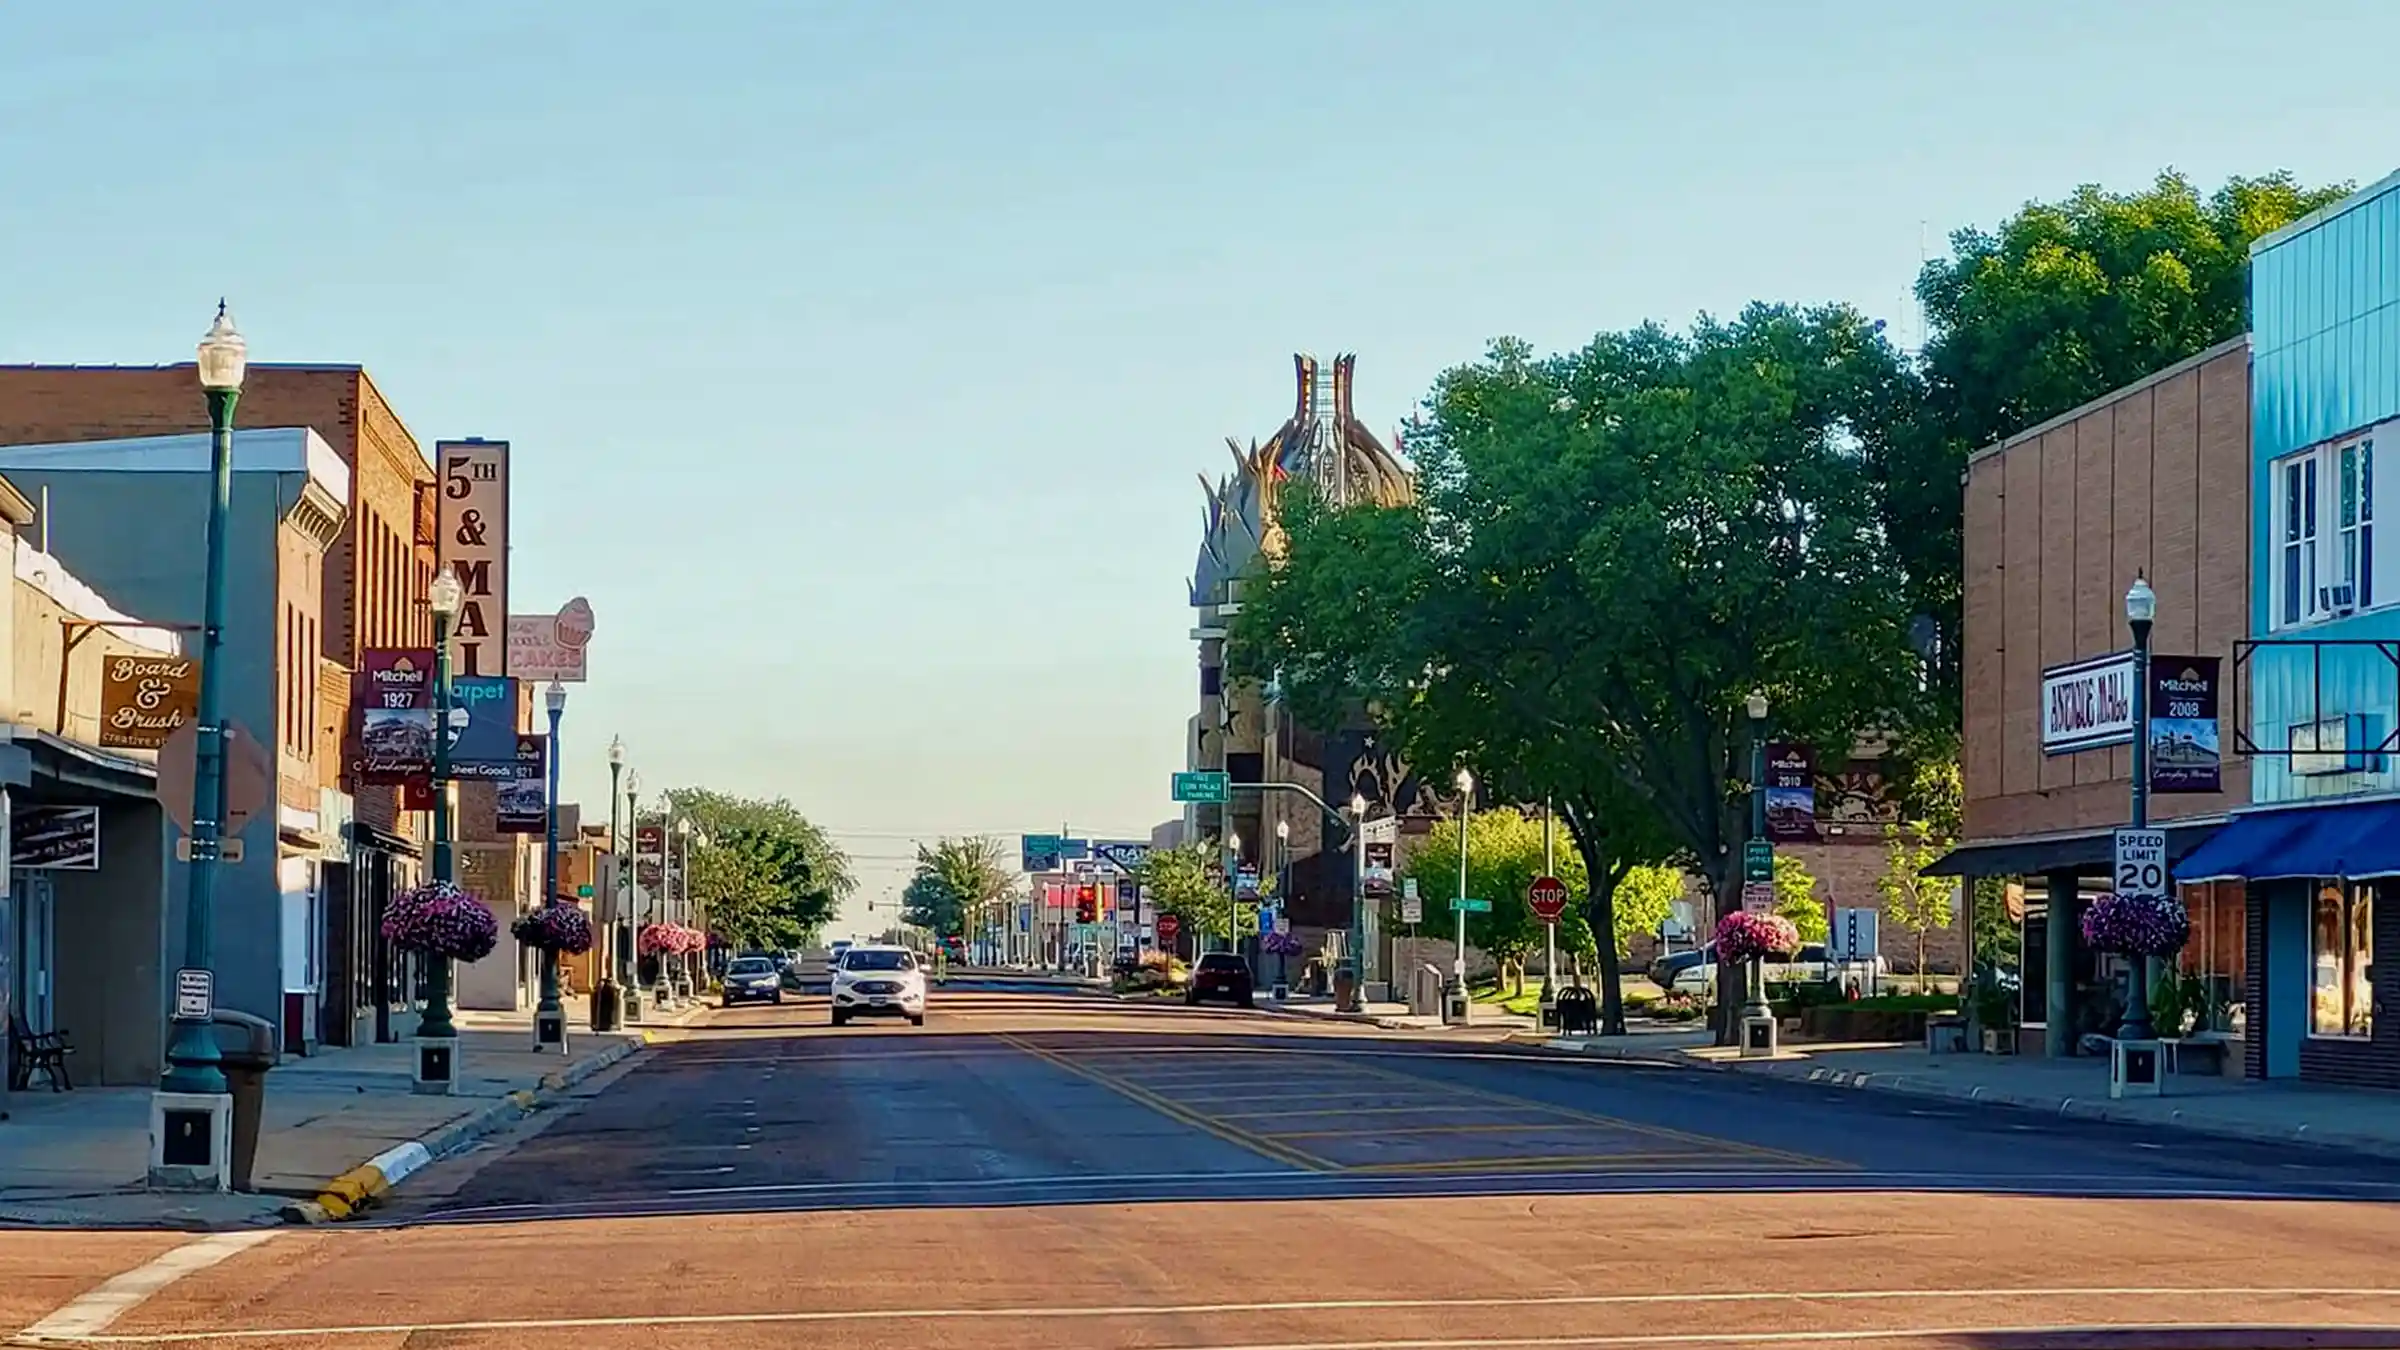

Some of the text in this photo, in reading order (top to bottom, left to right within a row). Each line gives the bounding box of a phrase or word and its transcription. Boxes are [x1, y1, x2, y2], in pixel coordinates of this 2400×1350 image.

[446, 456, 497, 499] 5TH
[456, 508, 487, 546] &
[111, 658, 190, 682] Board
[372, 670, 424, 683] Mitchell
[136, 678, 171, 709] &
[2160, 679, 2208, 692] Mitchell
[383, 692, 413, 708] 1927
[434, 681, 505, 708] arpet
[2169, 702, 2199, 717] 2008
[110, 707, 185, 729] Brush
[479, 765, 511, 776] Goods
[2119, 836, 2163, 847] SPEED
[2123, 850, 2158, 861] LIMIT
[2120, 864, 2162, 889] 20
[1531, 889, 1565, 903] STOP
